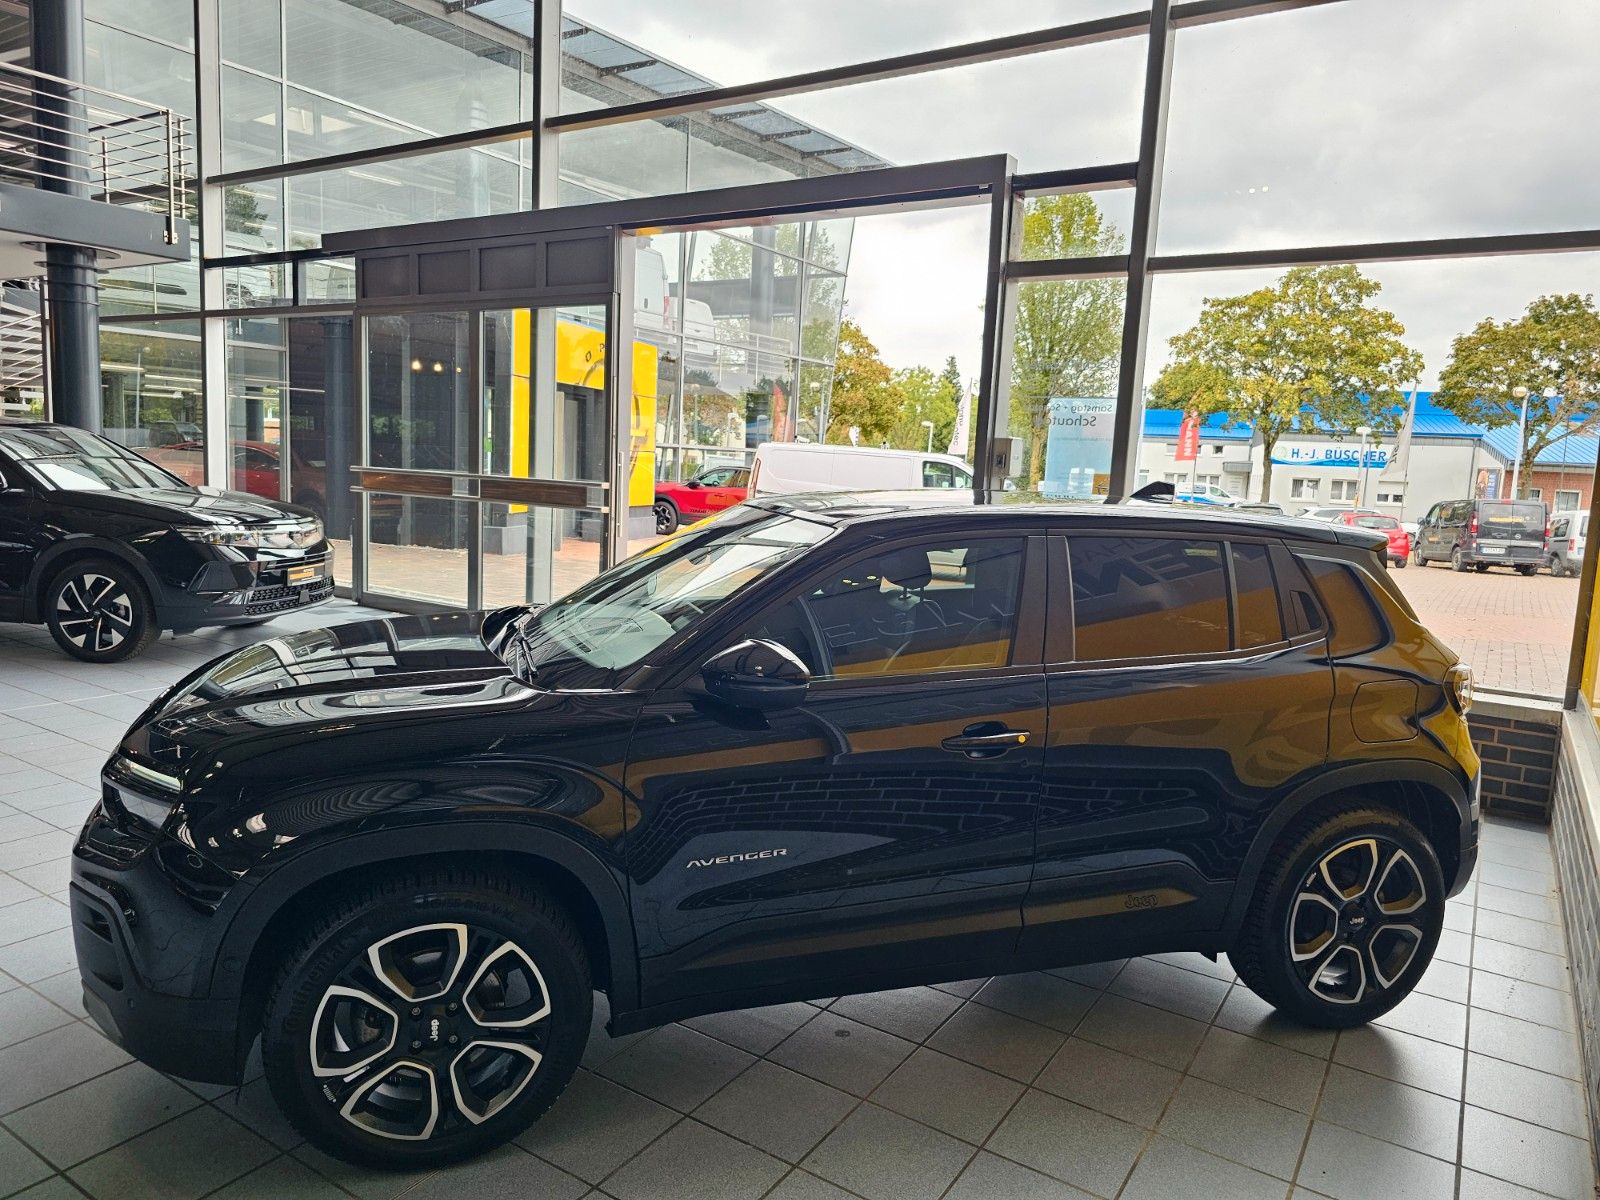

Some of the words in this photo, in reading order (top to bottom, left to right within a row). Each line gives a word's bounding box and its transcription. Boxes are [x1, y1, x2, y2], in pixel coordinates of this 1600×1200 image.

[585, 343, 605, 362] OP
[1325, 446, 1387, 462] BÜSCHER
[686, 848, 788, 868] AVENGER
[1124, 894, 1158, 909] Jeep
[429, 1019, 440, 1042] Jeep
